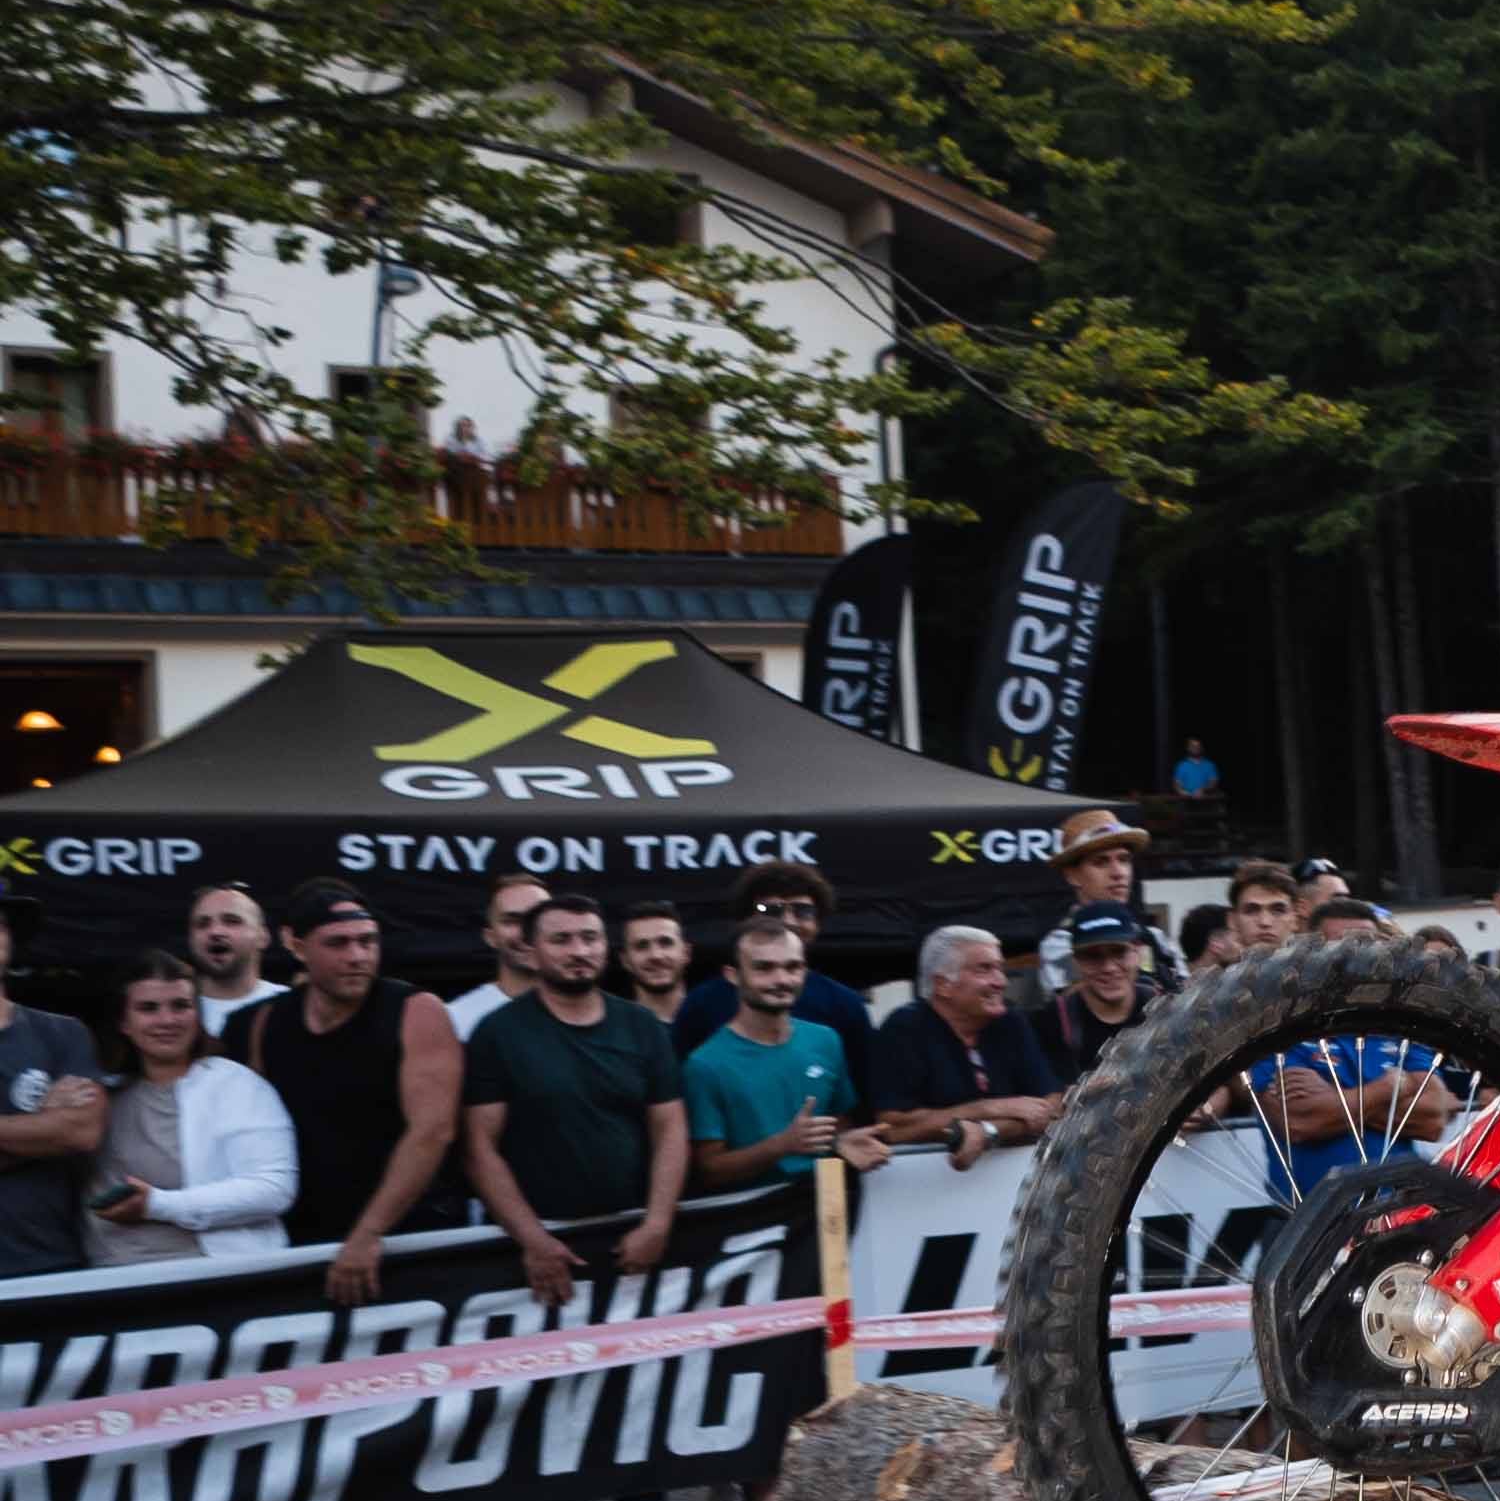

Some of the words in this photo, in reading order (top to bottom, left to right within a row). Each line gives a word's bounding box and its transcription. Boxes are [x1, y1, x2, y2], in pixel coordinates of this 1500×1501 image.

[821, 601, 873, 729] RIP
[380, 760, 735, 801] GRIP
[337, 832, 496, 873] STAY
[517, 833, 605, 874] ON
[625, 829, 818, 873] TRACK
[929, 827, 1066, 864] X-GRI
[1361, 1403, 1469, 1422] ACERBIS
